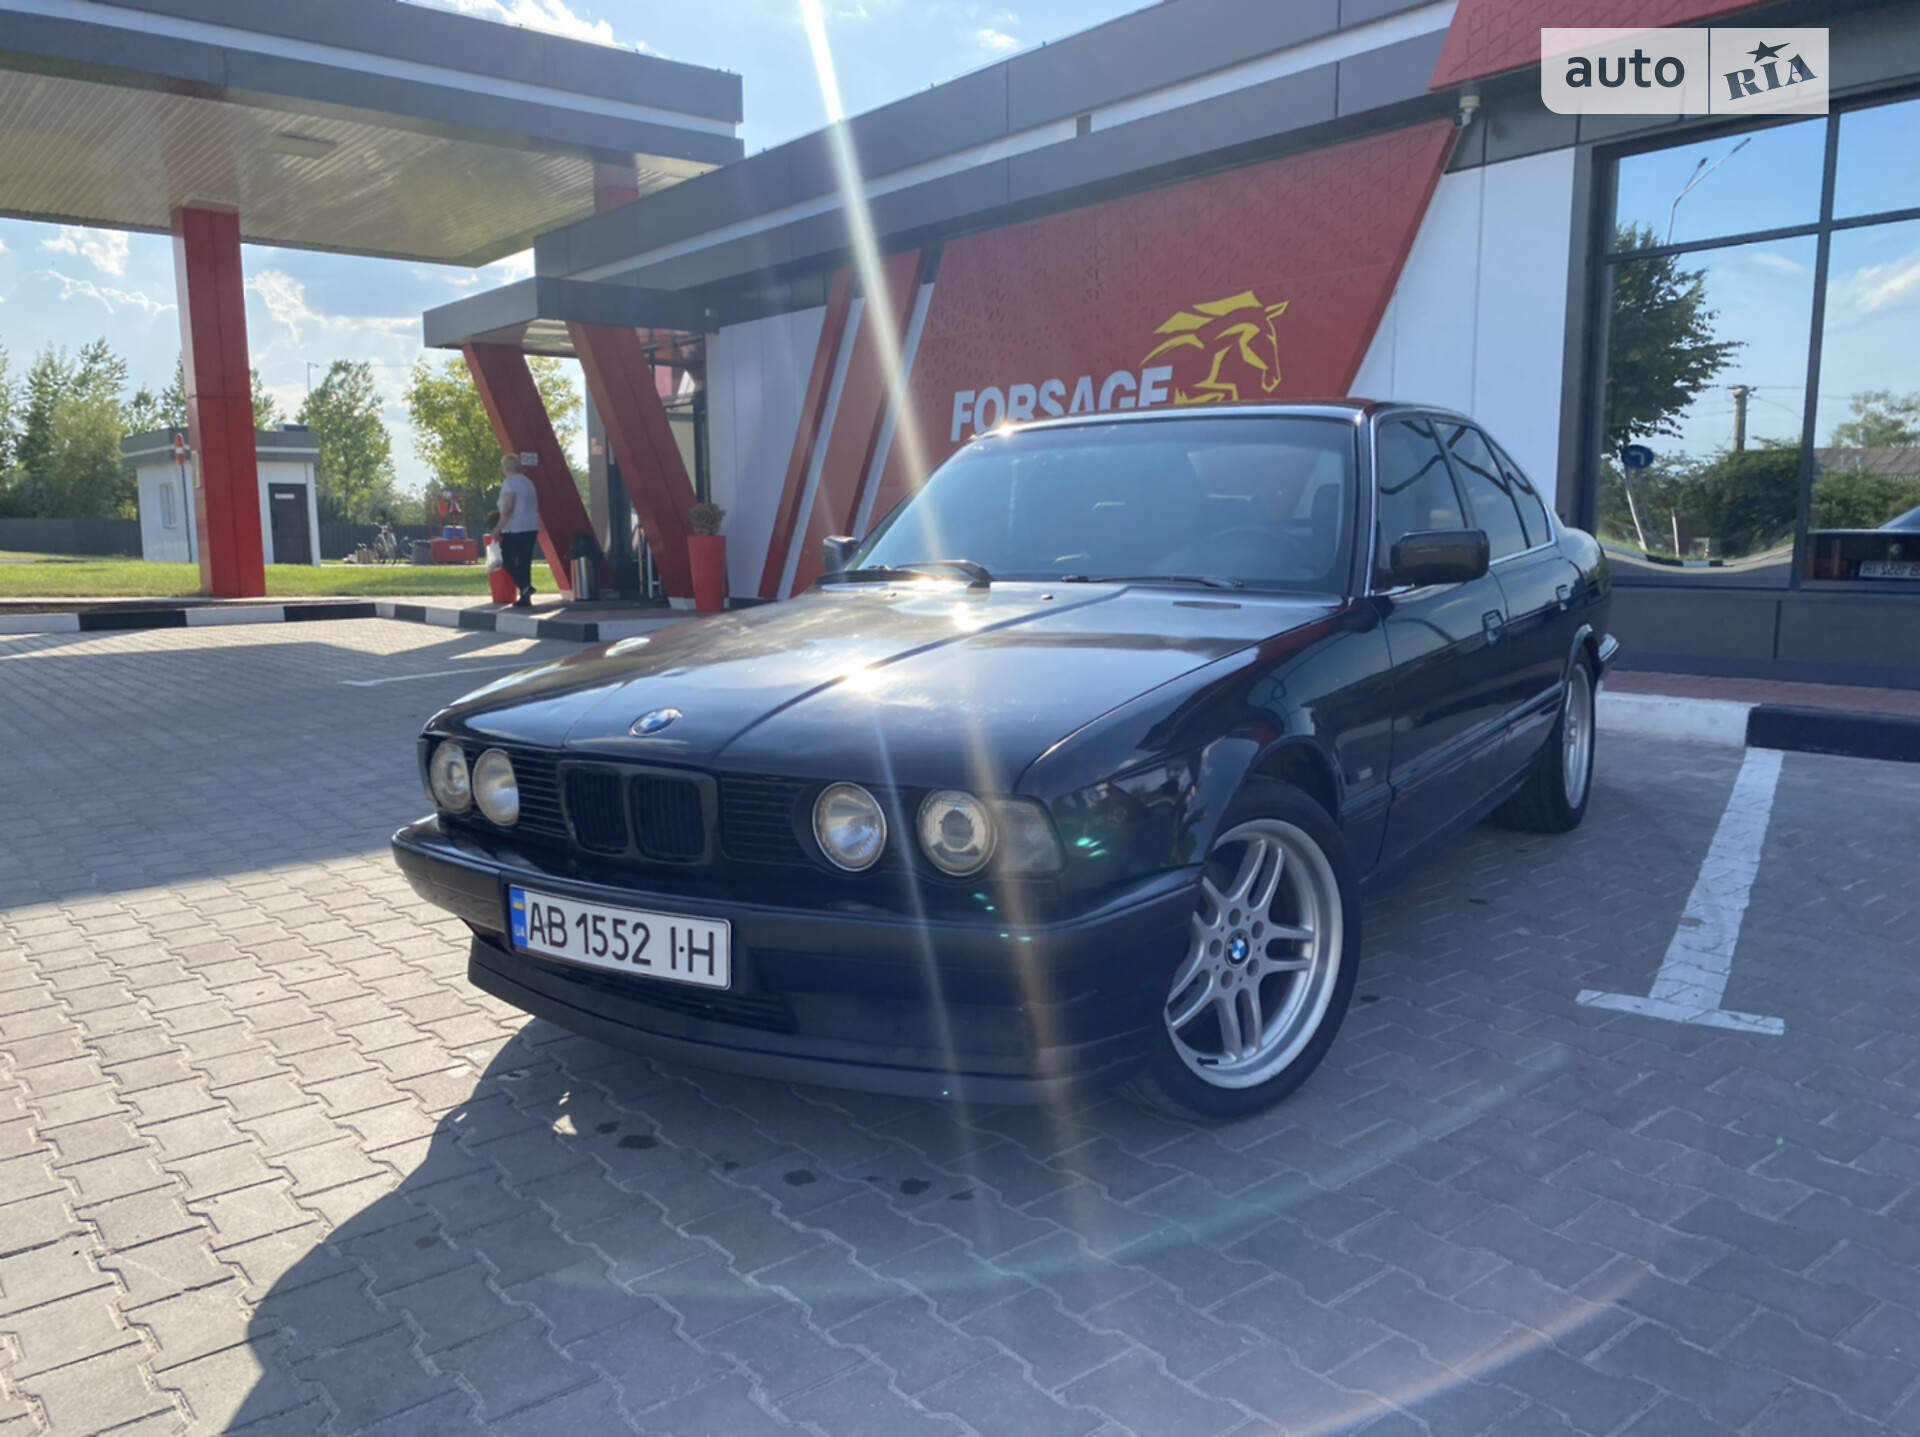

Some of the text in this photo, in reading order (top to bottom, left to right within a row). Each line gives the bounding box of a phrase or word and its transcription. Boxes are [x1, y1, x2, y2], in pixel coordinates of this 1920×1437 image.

[951, 365, 1174, 442] FORSAGE
[529, 902, 568, 949] AB
[575, 913, 652, 966] 1552
